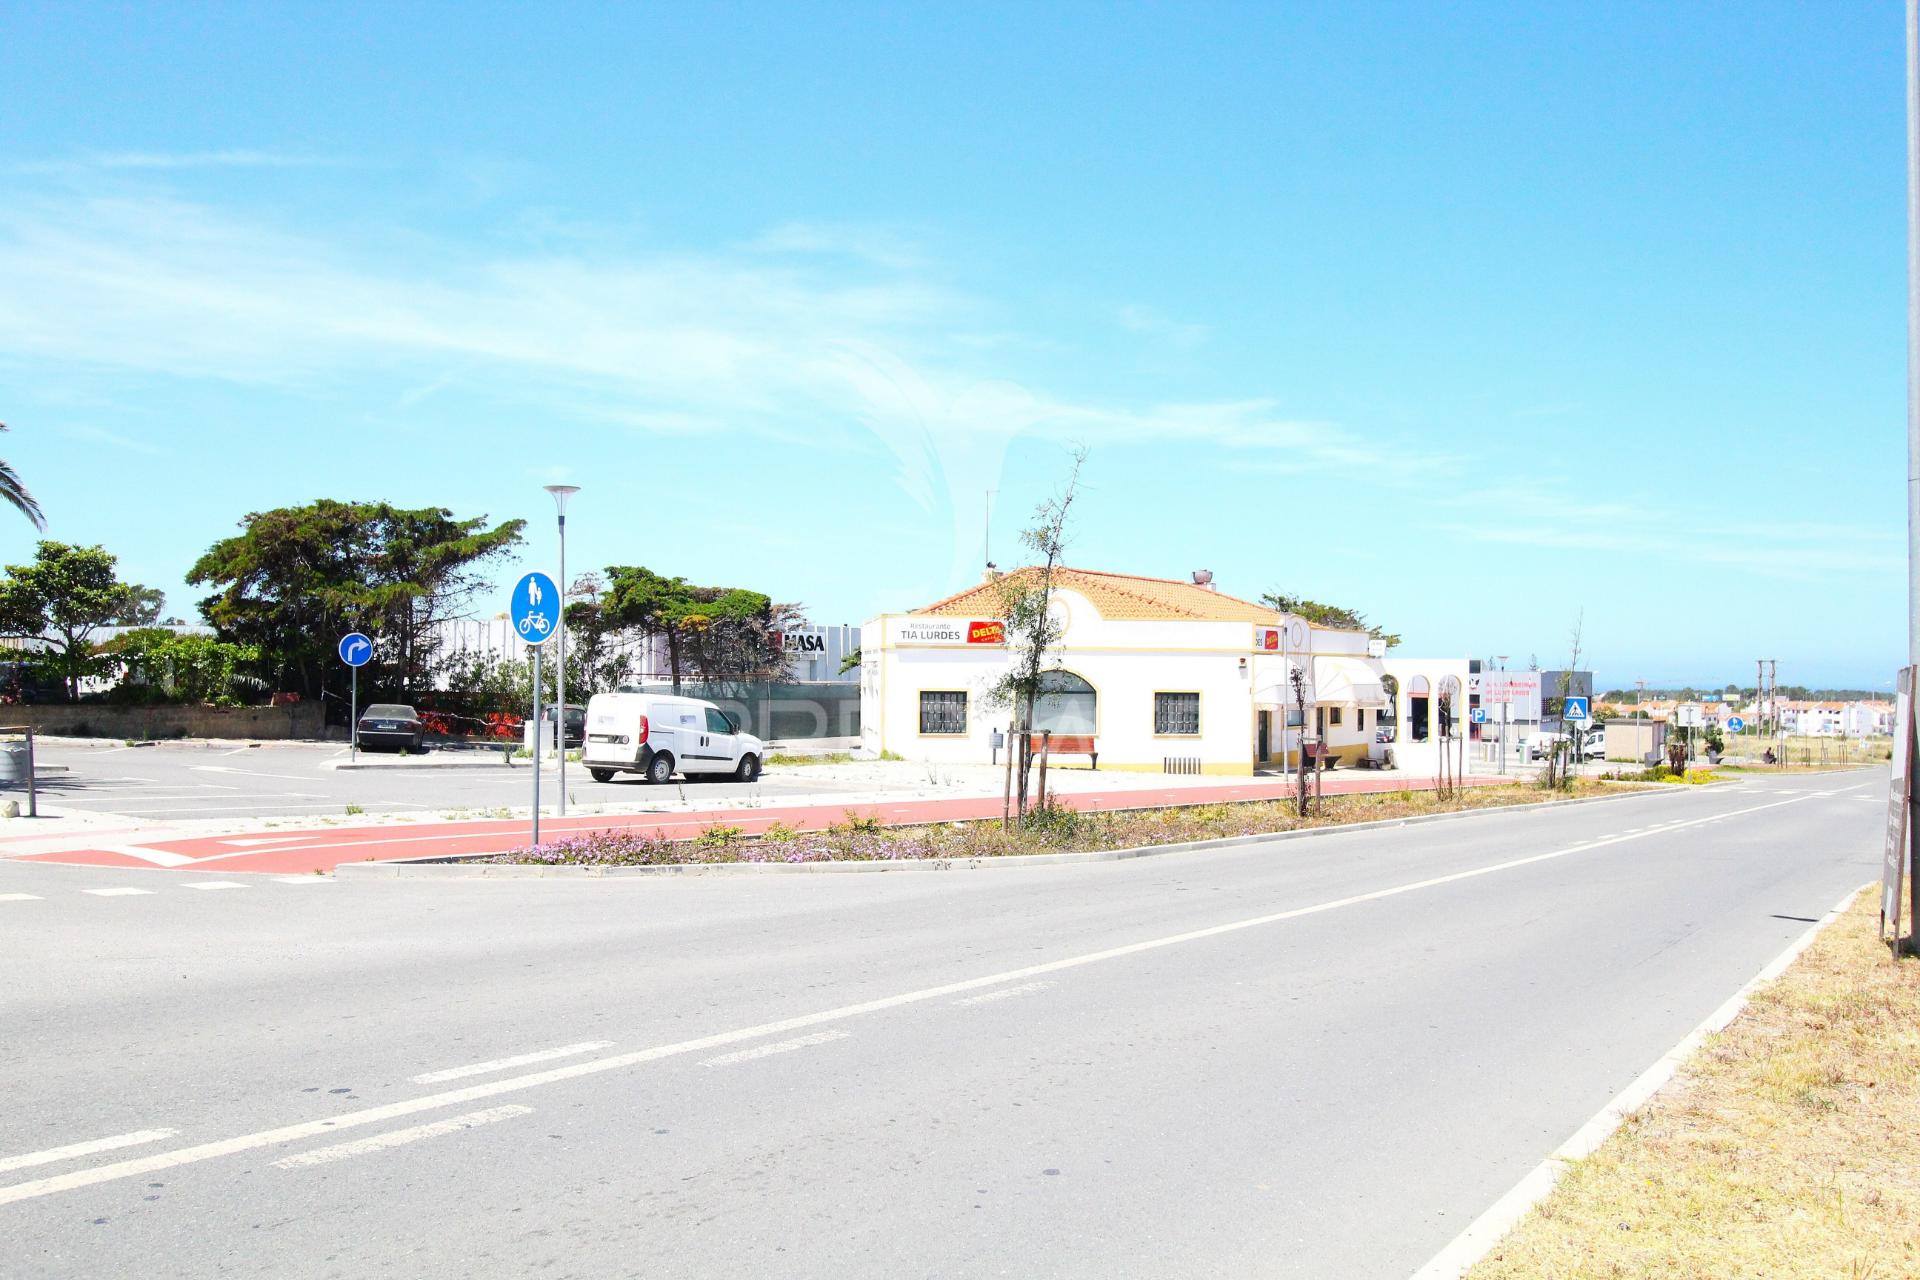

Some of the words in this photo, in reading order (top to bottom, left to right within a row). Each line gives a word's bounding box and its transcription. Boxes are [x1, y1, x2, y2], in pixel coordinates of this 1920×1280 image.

[901, 631, 918, 639] TIA
[921, 631, 960, 640] LURDES
[1475, 710, 1483, 722] P
